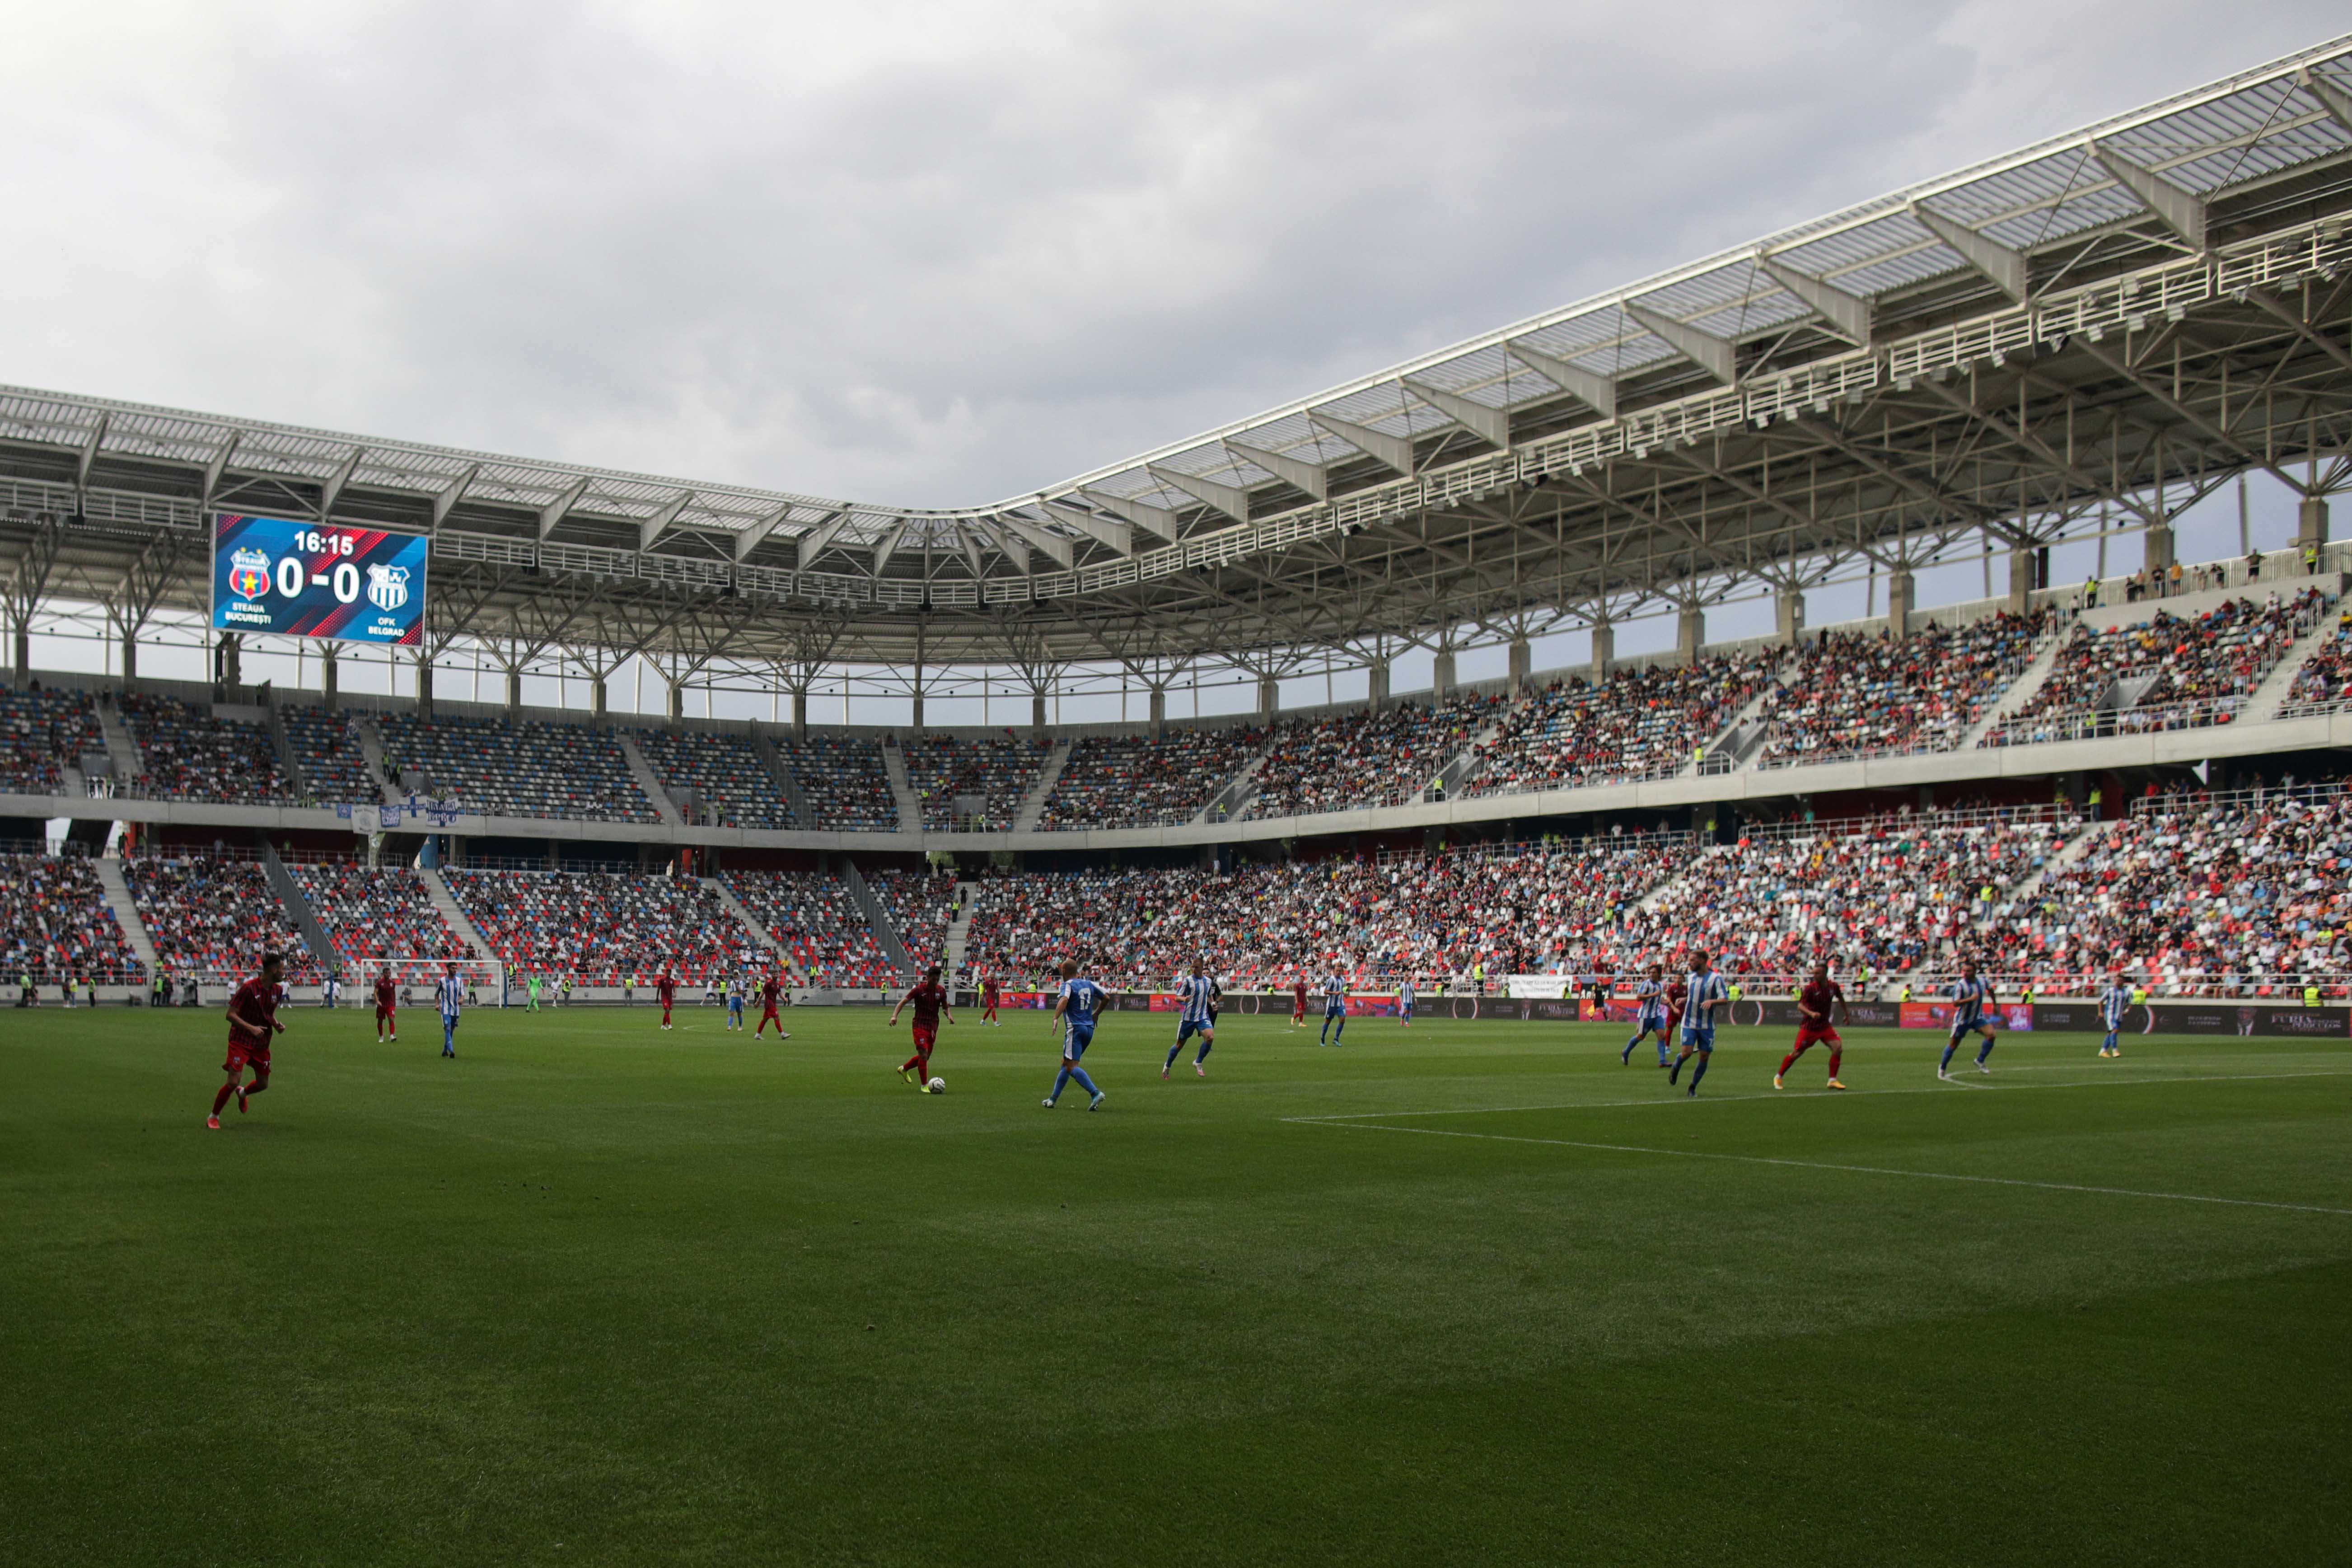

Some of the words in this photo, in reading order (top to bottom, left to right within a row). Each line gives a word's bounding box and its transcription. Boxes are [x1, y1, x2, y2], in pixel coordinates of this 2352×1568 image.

[295, 530, 354, 556] 16:15
[232, 602, 265, 614] STEAUA
[378, 617, 396, 626] OFK
[368, 626, 405, 637] BELGRAD
[1078, 988, 1091, 1010] 17
